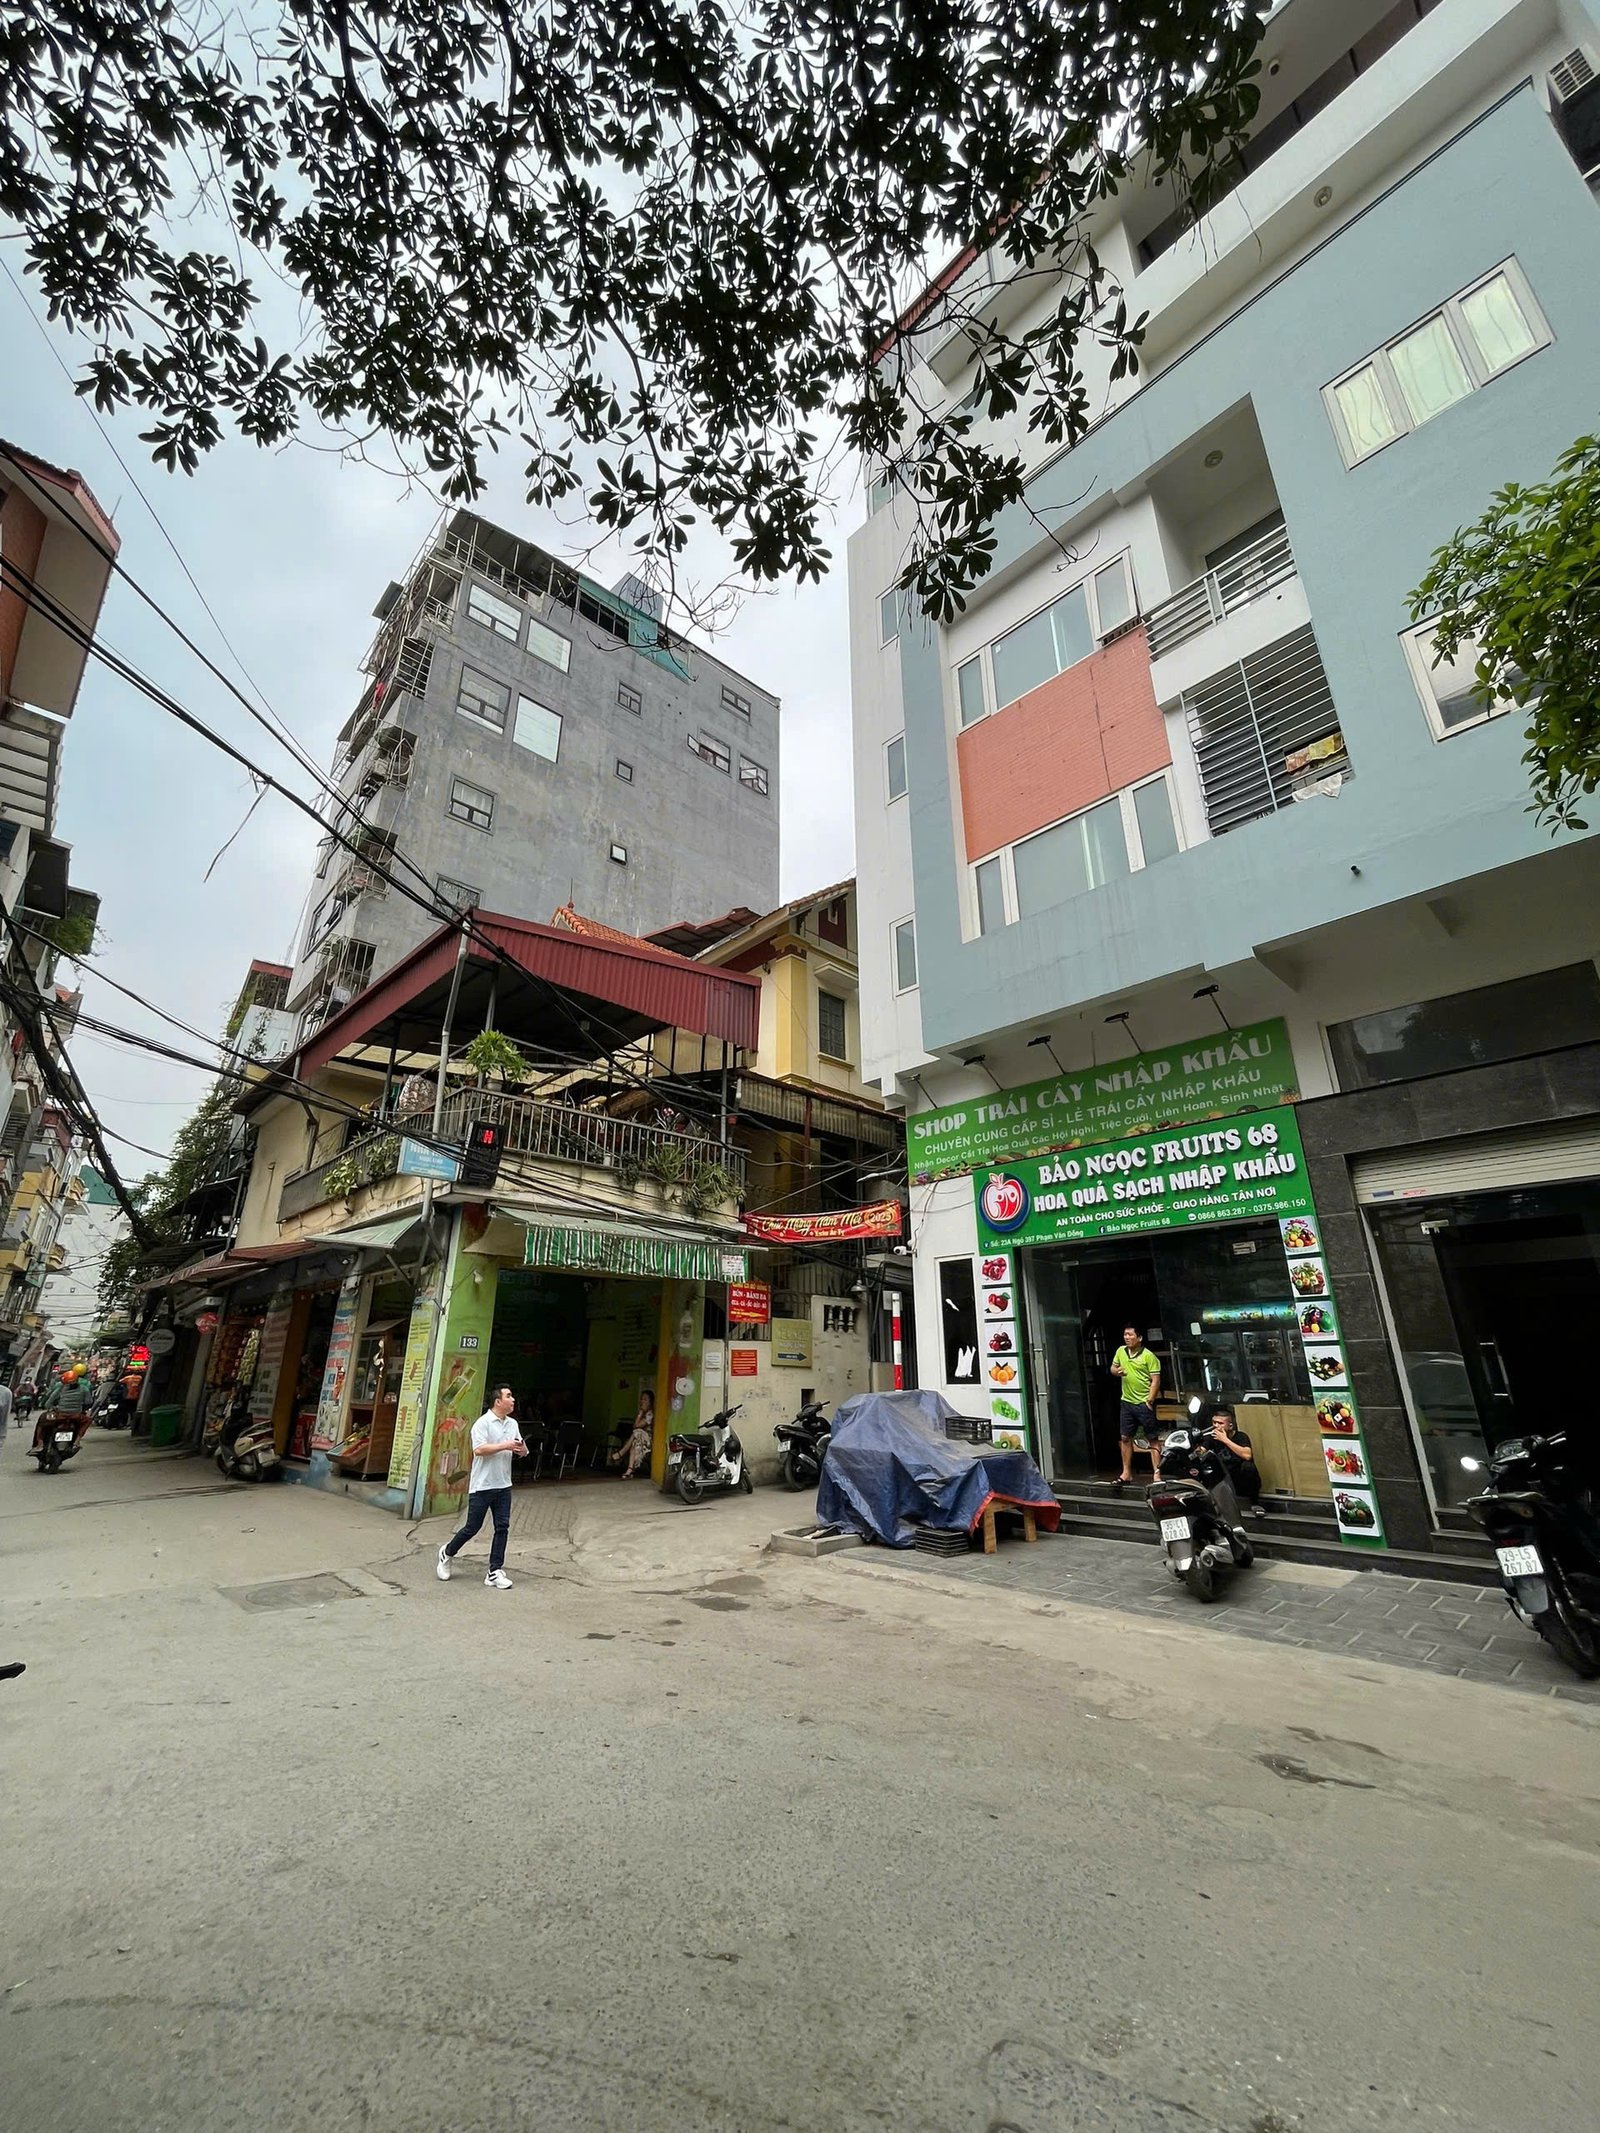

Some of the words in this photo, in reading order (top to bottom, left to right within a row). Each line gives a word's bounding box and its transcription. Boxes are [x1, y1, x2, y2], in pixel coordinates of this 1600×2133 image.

[914, 1112, 967, 1139] SHOP
[974, 1093, 1028, 1125] TRÁI
[1036, 1082, 1084, 1109] CÂY
[1095, 1061, 1171, 1096] NHẬP
[1182, 1031, 1272, 1074] KHẨU
[914, 1158, 934, 1170] Nhận
[936, 1154, 959, 1166] Decor
[992, 1143, 1010, 1154] Hoa
[1011, 1138, 1030, 1150] Quả
[1032, 1134, 1050, 1144] Các
[1052, 1130, 1068, 1142] Hội
[1100, 1119, 1122, 1131] Tiệc
[1155, 1106, 1180, 1120] Liên
[1221, 1092, 1250, 1105] Sinh
[1253, 1083, 1284, 1097] Nhật
[924, 1136, 971, 1156] CHUYÊN
[974, 1128, 1008, 1144] CUNG
[1012, 1119, 1038, 1136] CẤP
[1042, 1116, 1054, 1129] SỈ
[1066, 1106, 1083, 1124] LẺ
[1089, 1099, 1121, 1119] TRÁI
[1125, 1092, 1161, 1111] CÂY
[1161, 1081, 1206, 1102] NHẬP
[1212, 1066, 1261, 1091] KHẨU
[1033, 1192, 1068, 1212] HOA
[1071, 1180, 1109, 1207] QUẢ
[1113, 1175, 1165, 1201] SẠCH
[1169, 1164, 1227, 1191] NHẬP
[1233, 1147, 1296, 1181] KHẨU
[1038, 1154, 1081, 1185] BẢO
[1086, 1147, 1147, 1176] NGỌC
[1151, 1128, 1242, 1165] FRUITS
[1247, 1123, 1278, 1147] 68
[1056, 1217, 1069, 1227] AN
[1069, 1213, 1094, 1225] TOÀN
[1095, 1210, 1115, 1221] CHO
[1116, 1206, 1136, 1219] SỨC
[1137, 1201, 1165, 1215] KHỎE
[1172, 1198, 1198, 1210] GIAO
[1199, 1193, 1230, 1206] HÀNG
[1231, 1189, 1254, 1201] TẬN
[1256, 1186, 1277, 1198] NƠI
[1106, 1223, 1121, 1233] Bảo
[1121, 1221, 1139, 1232] Ngọc
[1140, 1218, 1160, 1228] Fruits
[1161, 1217, 1171, 1226] 68
[1197, 1212, 1216, 1221] 0866
[1036, 1233, 1054, 1243] Phạm
[1067, 1229, 1084, 1239] Đồng
[462, 1337, 478, 1347] 133
